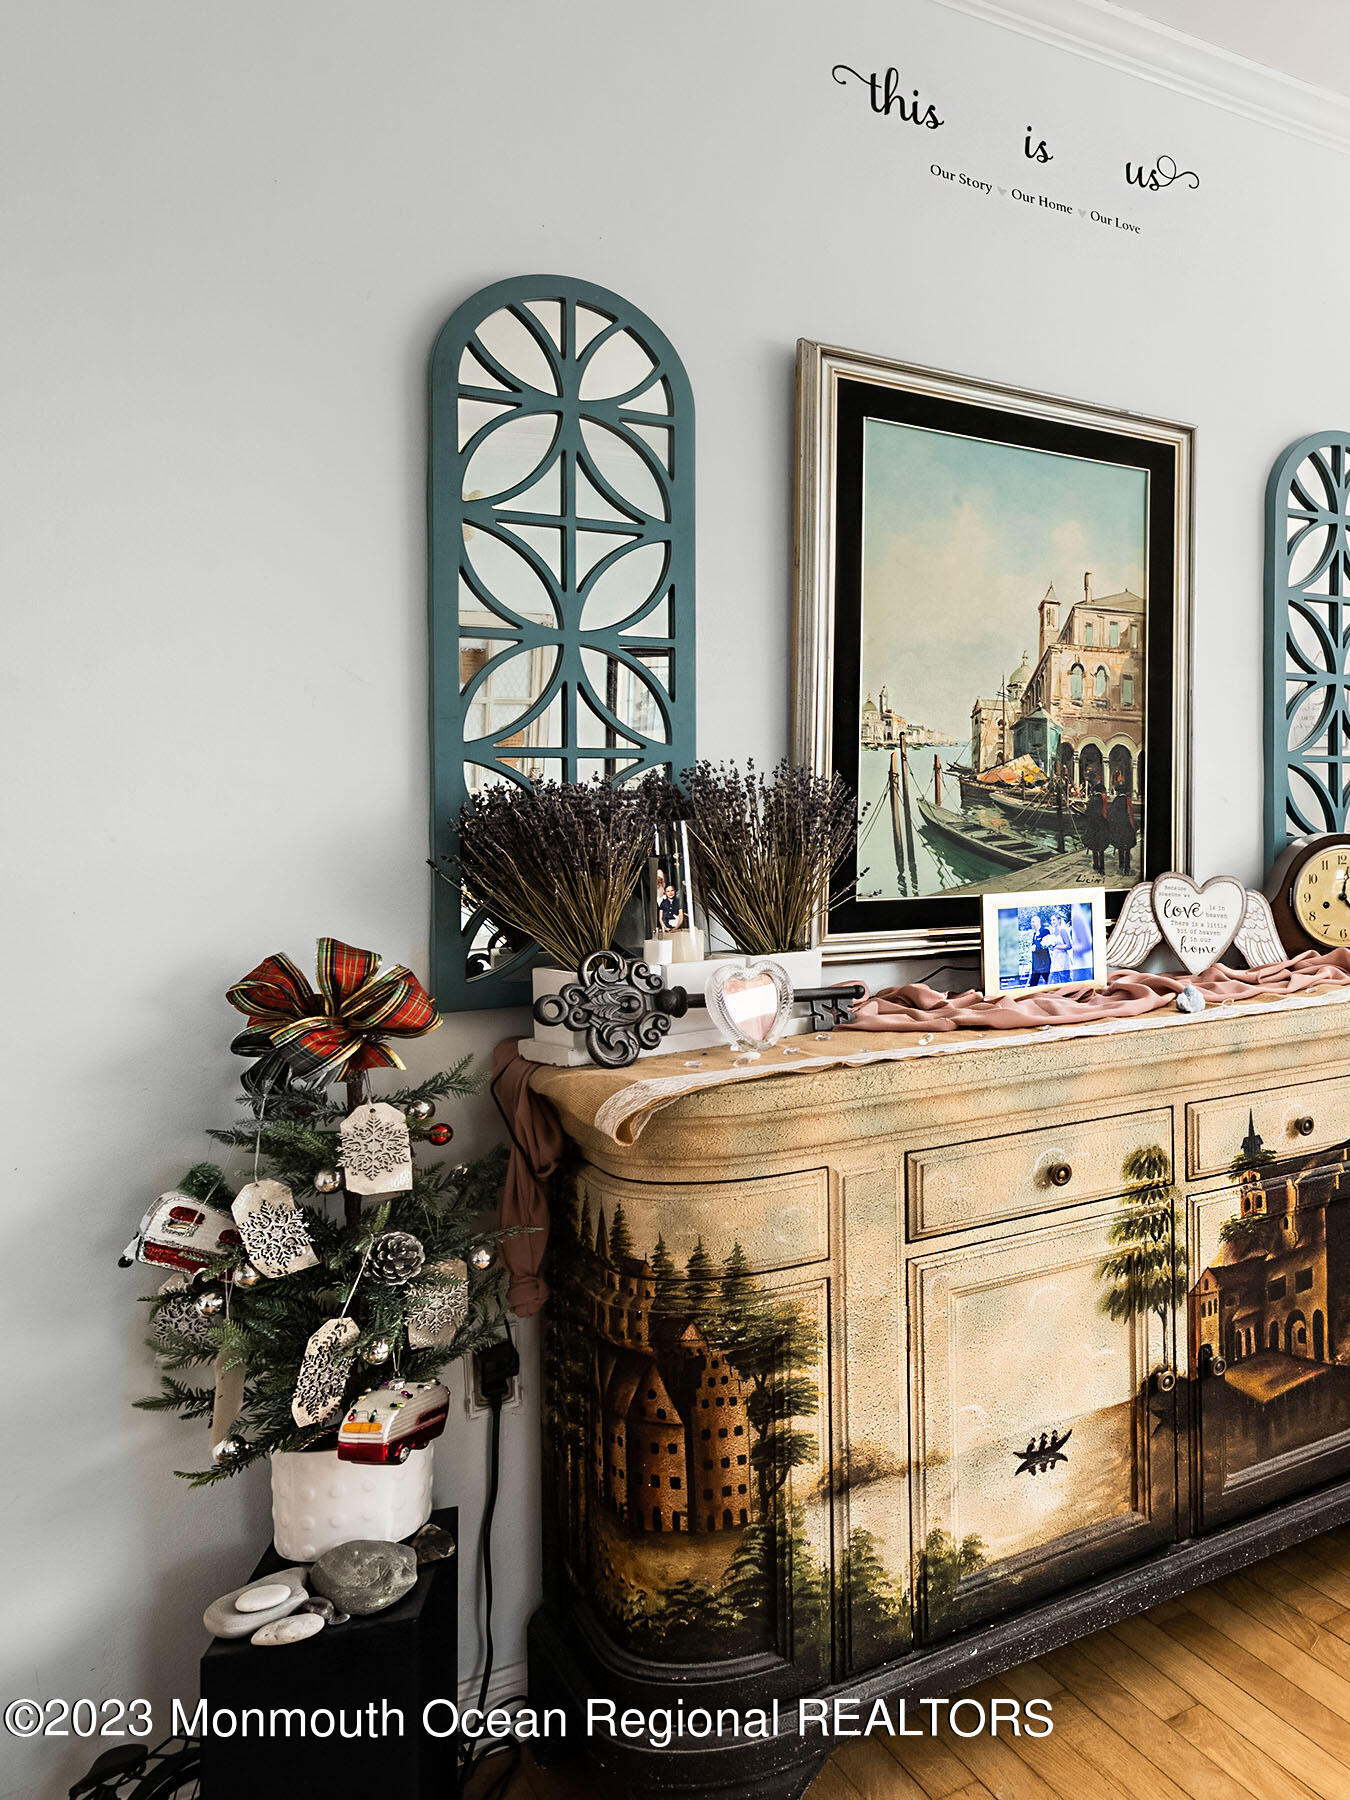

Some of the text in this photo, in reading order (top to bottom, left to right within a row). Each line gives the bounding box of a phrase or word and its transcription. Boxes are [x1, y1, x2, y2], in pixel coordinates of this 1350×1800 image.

[832, 64, 1200, 191] this is us
[930, 164, 1141, 235] Our Story Our Home Our Love
[1321, 860, 1329, 870] 11
[1337, 855, 1347, 865] 12
[1308, 874, 1318, 884] 10
[1303, 892, 1312, 903] 9
[1163, 898, 1204, 919] love
[1308, 911, 1317, 922] 8
[1191, 920, 1198, 928] is
[1206, 921, 1227, 929] little
[1322, 923, 1331, 935] 7
[1198, 928, 1221, 936] heaven
[1339, 928, 1348, 939] 6
[1180, 935, 1217, 954] home
